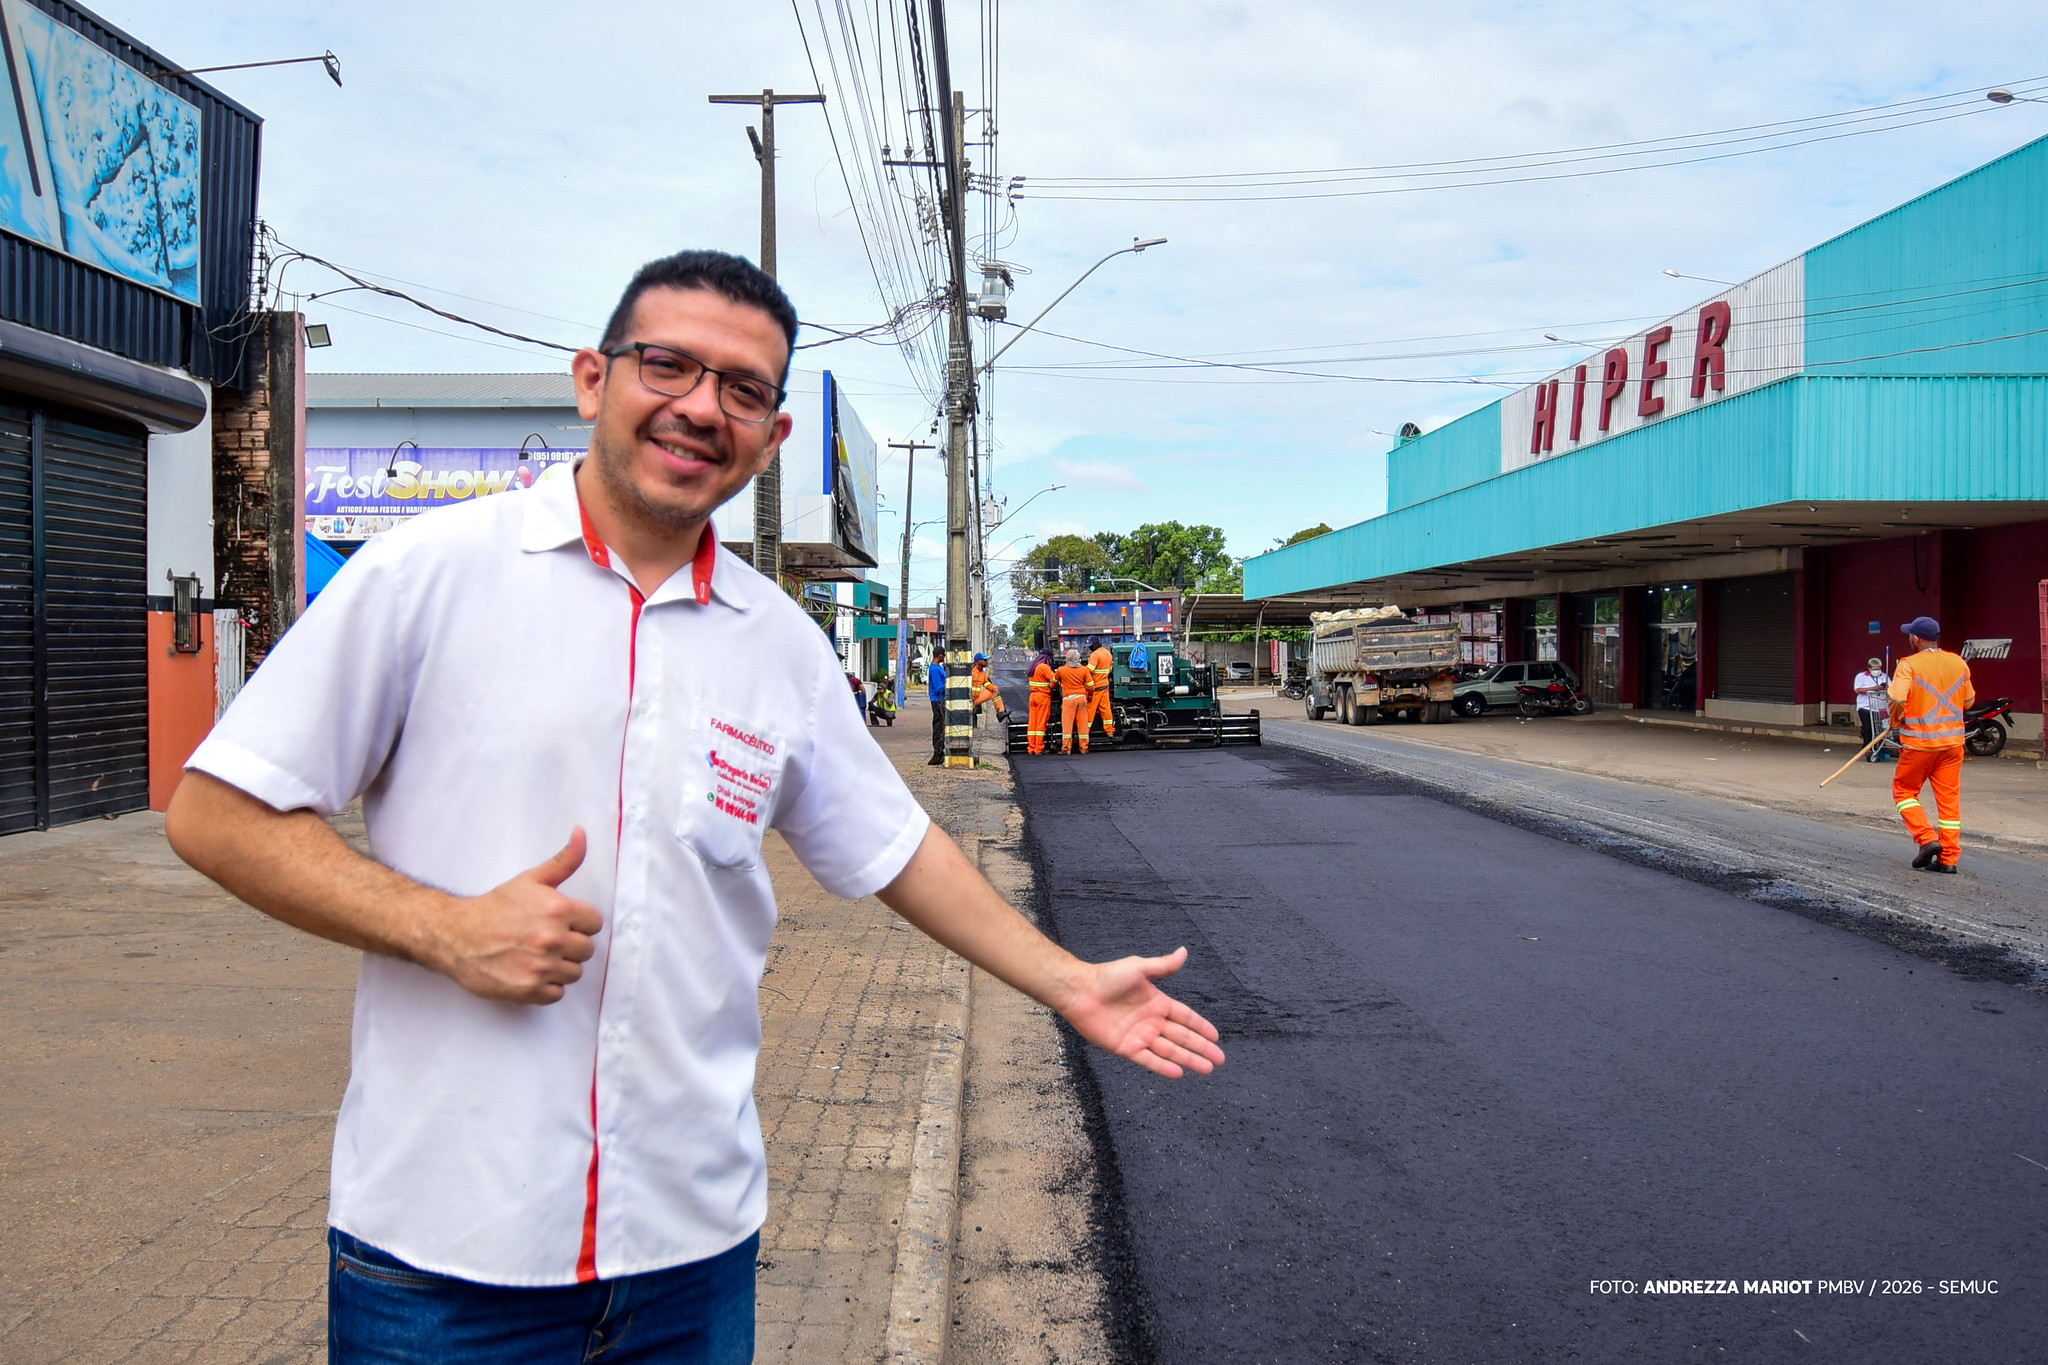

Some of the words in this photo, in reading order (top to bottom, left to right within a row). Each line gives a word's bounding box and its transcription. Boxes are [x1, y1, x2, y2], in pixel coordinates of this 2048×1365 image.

[1531, 301, 1731, 454] HIPER
[533, 452, 549, 461] (95)
[363, 505, 379, 514] PARA
[380, 505, 401, 514] FESTAS
[401, 505, 406, 514] E
[710, 717, 775, 755] FARMACÊUTICO
